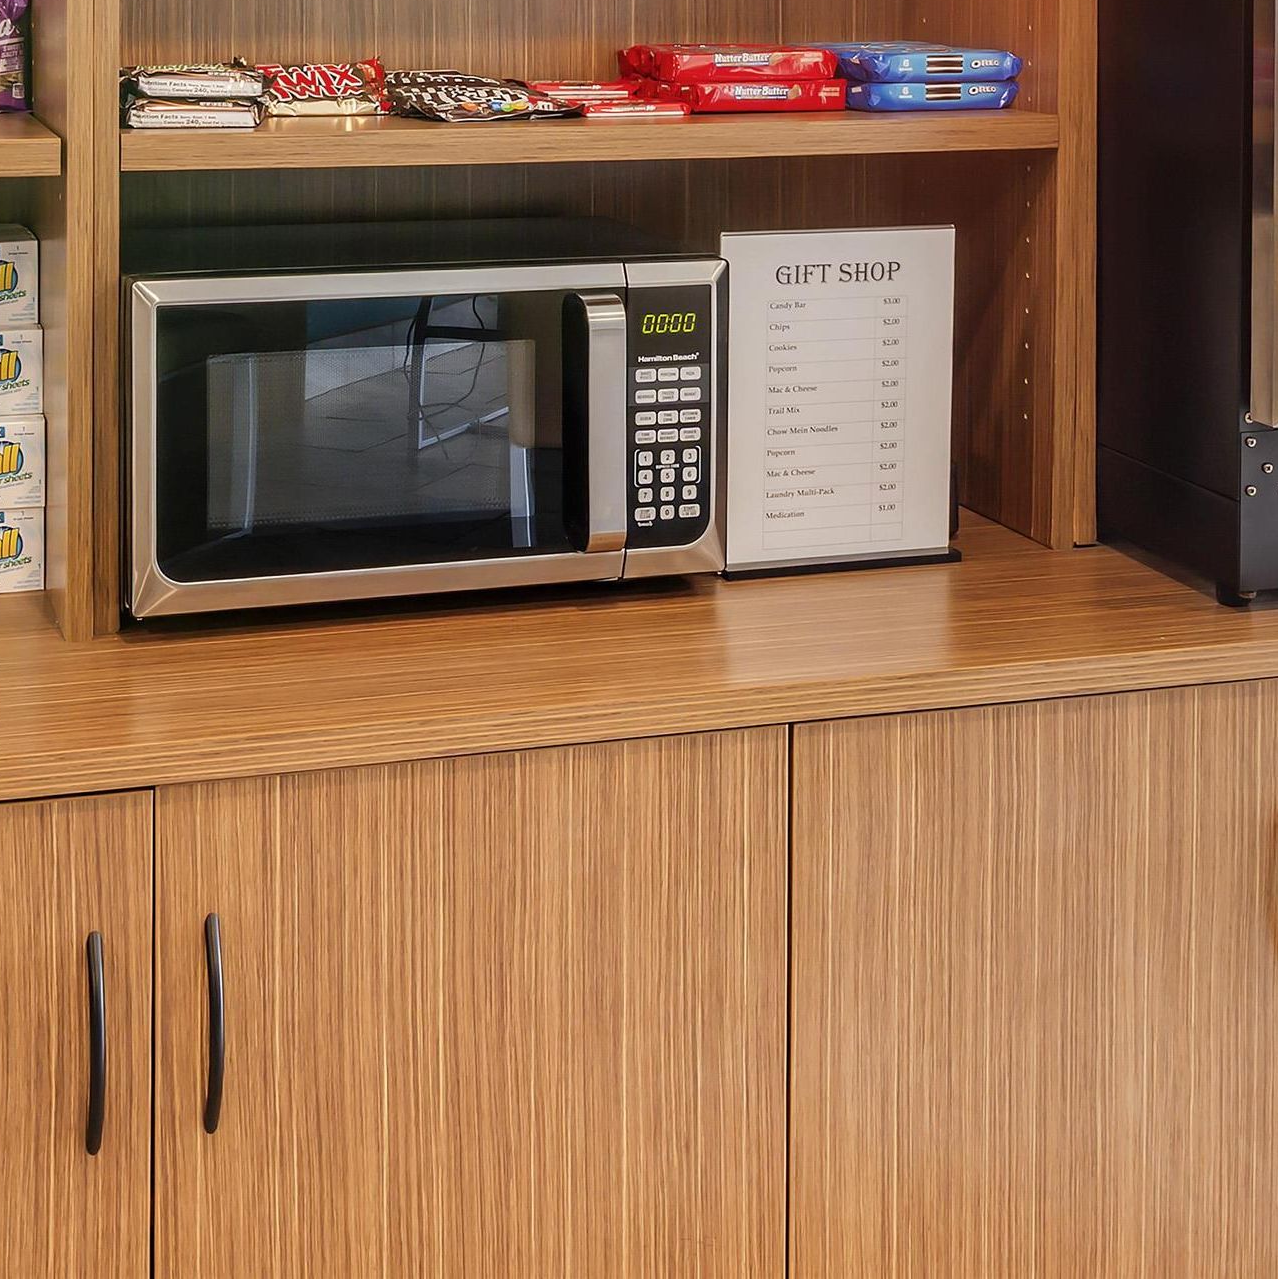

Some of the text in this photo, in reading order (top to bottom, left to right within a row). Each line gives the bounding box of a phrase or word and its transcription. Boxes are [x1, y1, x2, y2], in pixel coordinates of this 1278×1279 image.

[714, 52, 770, 63] Nutter Butter
[971, 59, 1000, 69] OREO
[734, 85, 789, 96] Nutter Butter
[968, 86, 997, 95] OREO
[775, 261, 902, 285] GIFT SHOP
[0, 290, 27, 302] sheets
[769, 300, 807, 310] Candy Bar
[642, 312, 697, 335] 00:00
[769, 323, 790, 332] Chips
[768, 344, 797, 352] Cookies
[638, 353, 697, 363] Hamilton Beach
[768, 365, 798, 374] Popcorn
[2, 378, 30, 392] sheets
[768, 384, 818, 394] Mac & Cheese
[768, 406, 801, 415] Trail Mix
[767, 425, 839, 437] Chow Mein Noodles
[766, 448, 796, 458] Popcorn
[766, 467, 816, 478] Mac & Cheese
[765, 487, 835, 499] Laundry Multi-Pack
[765, 511, 805, 520] Medication
